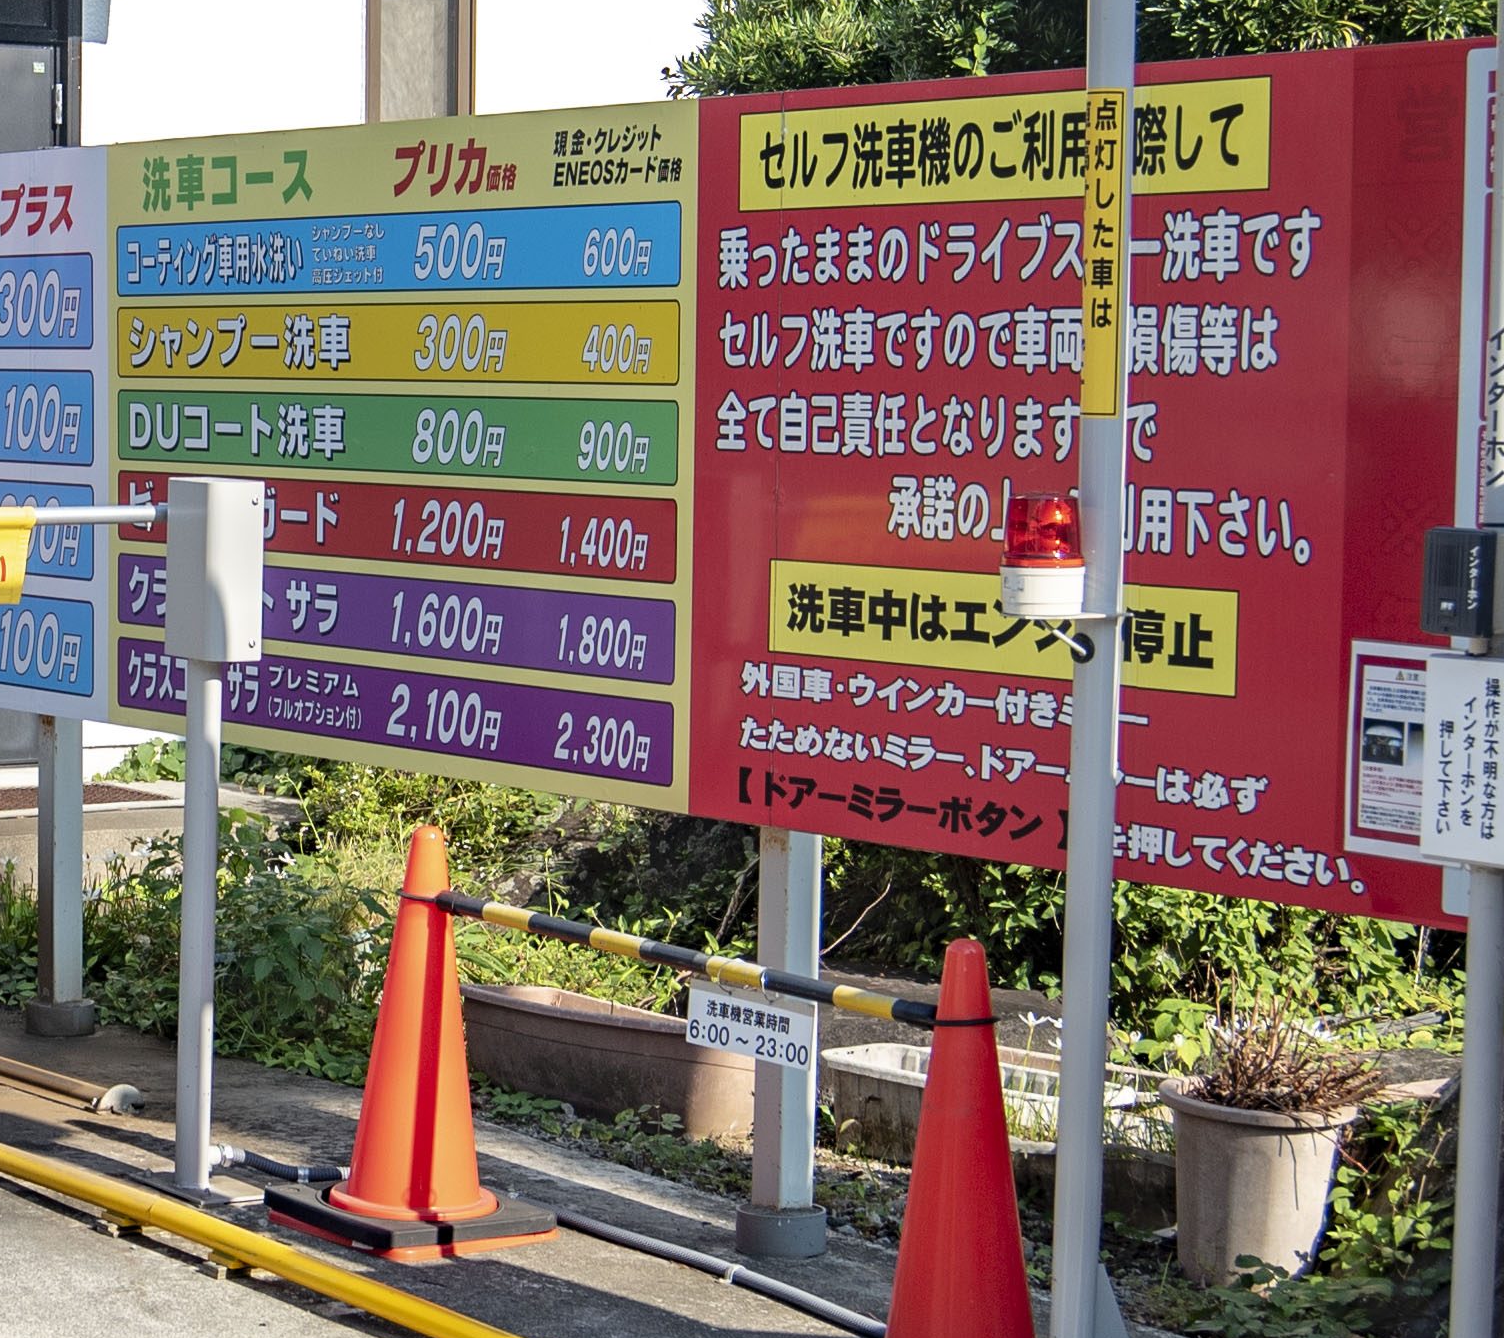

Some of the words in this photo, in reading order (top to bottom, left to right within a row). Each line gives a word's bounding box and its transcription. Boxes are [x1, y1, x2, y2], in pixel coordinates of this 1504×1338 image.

[553, 125, 663, 157] 現金・クレジット
[553, 158, 682, 188] ENEOSカード価格
[760, 103, 1245, 189] セルフ洗車機のご利用際して
[0, 183, 73, 237] プラス
[143, 150, 312, 211] 洗車コース
[311, 223, 385, 240] シャンプーなし
[1091, 98, 1118, 329] 点灯した車は
[126, 231, 303, 285] コーティング車用水洗い
[311, 245, 377, 261] ていねい洗車
[311, 266, 385, 285] 高圧ジェット付
[413, 222, 507, 281] 500円
[582, 226, 652, 278] 600円
[717, 207, 1322, 289] 乗ったままのドライブスー洗車です
[129, 313, 351, 368] シャンプー洗車
[414, 313, 508, 372] 300円
[581, 323, 652, 375] 400円
[720, 302, 1278, 377] セルフ洗車ですので車両損傷等は
[3, 384, 82, 454] 100円
[129, 402, 346, 458] DUコート洗車
[412, 407, 507, 467] 800円
[576, 421, 650, 474] 900円
[716, 391, 1158, 463] 全て自己責任となりますで
[392, 499, 505, 559] 1,200円
[560, 516, 648, 570] 1,400円
[1467, 546, 1480, 610] インターホン
[0, 609, 81, 684] 100円
[392, 591, 503, 654] 1,600円
[559, 614, 647, 670] 1,800円
[268, 696, 362, 730] (フルオプション付)
[269, 665, 359, 698] プレミアム
[386, 684, 502, 751] 2,100円
[554, 712, 651, 772] 2,300円
[1481, 678, 1500, 839] 操作が不明な方は
[1436, 720, 1454, 834] 押して下さい
[1461, 697, 1477, 826] インターホンを
[689, 1019, 730, 1046] 6:00
[755, 1035, 809, 1065] 23:00
[706, 999, 790, 1035] 洗車機営業時間
